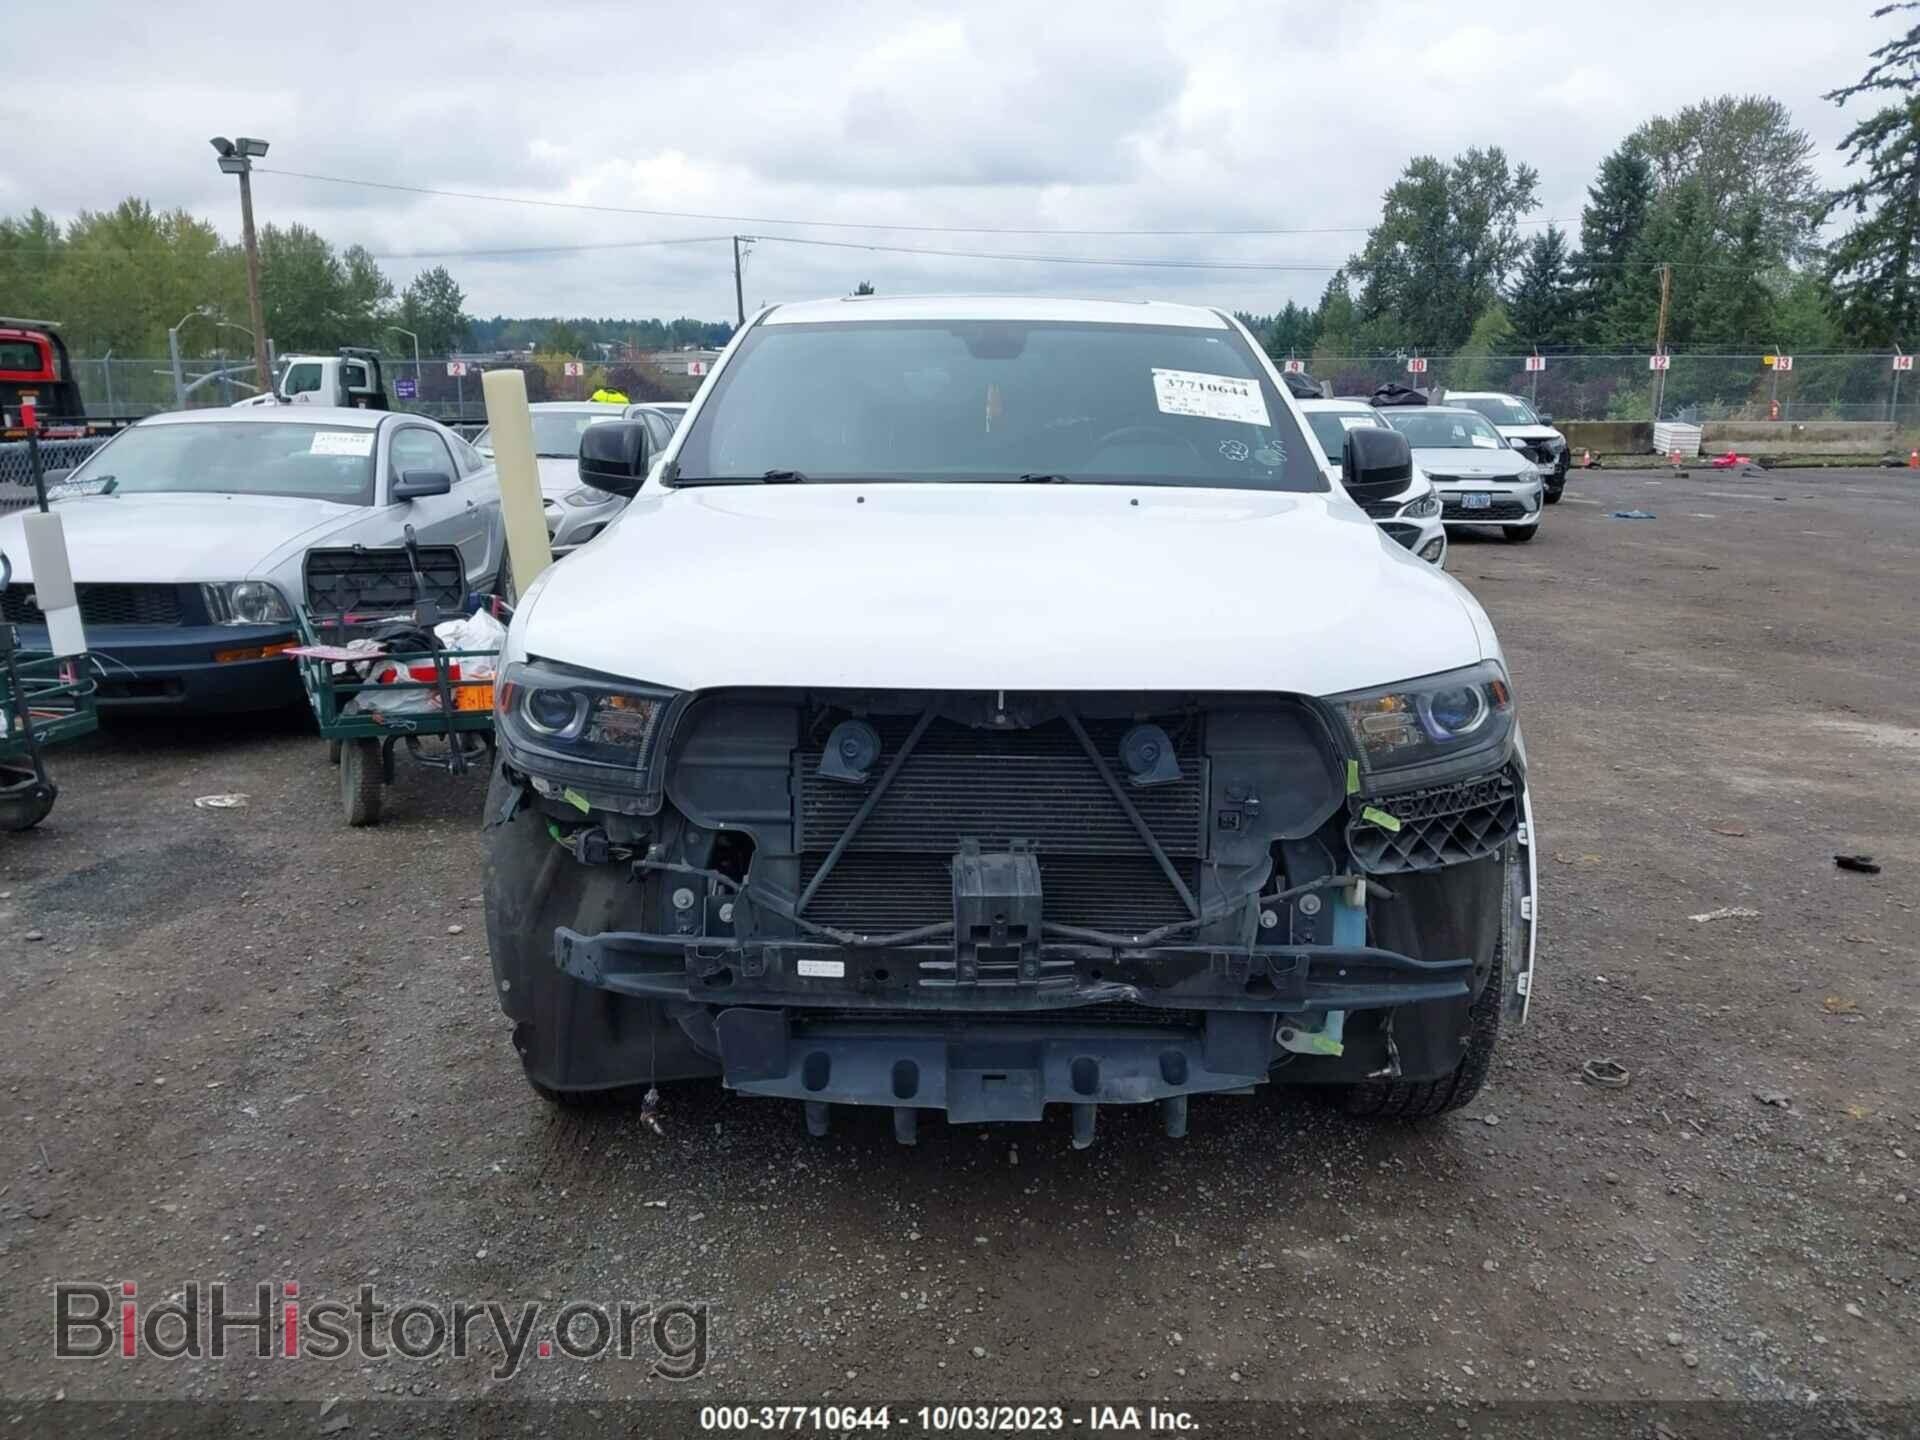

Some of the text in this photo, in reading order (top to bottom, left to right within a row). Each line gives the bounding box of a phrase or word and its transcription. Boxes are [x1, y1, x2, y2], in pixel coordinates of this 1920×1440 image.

[1411, 359, 1425, 371] 10
[1530, 357, 1541, 369] 11
[1654, 357, 1667, 369] 12
[1776, 358, 1790, 369] 13
[1896, 357, 1910, 369] 14
[1166, 378, 1249, 397] 37710644
